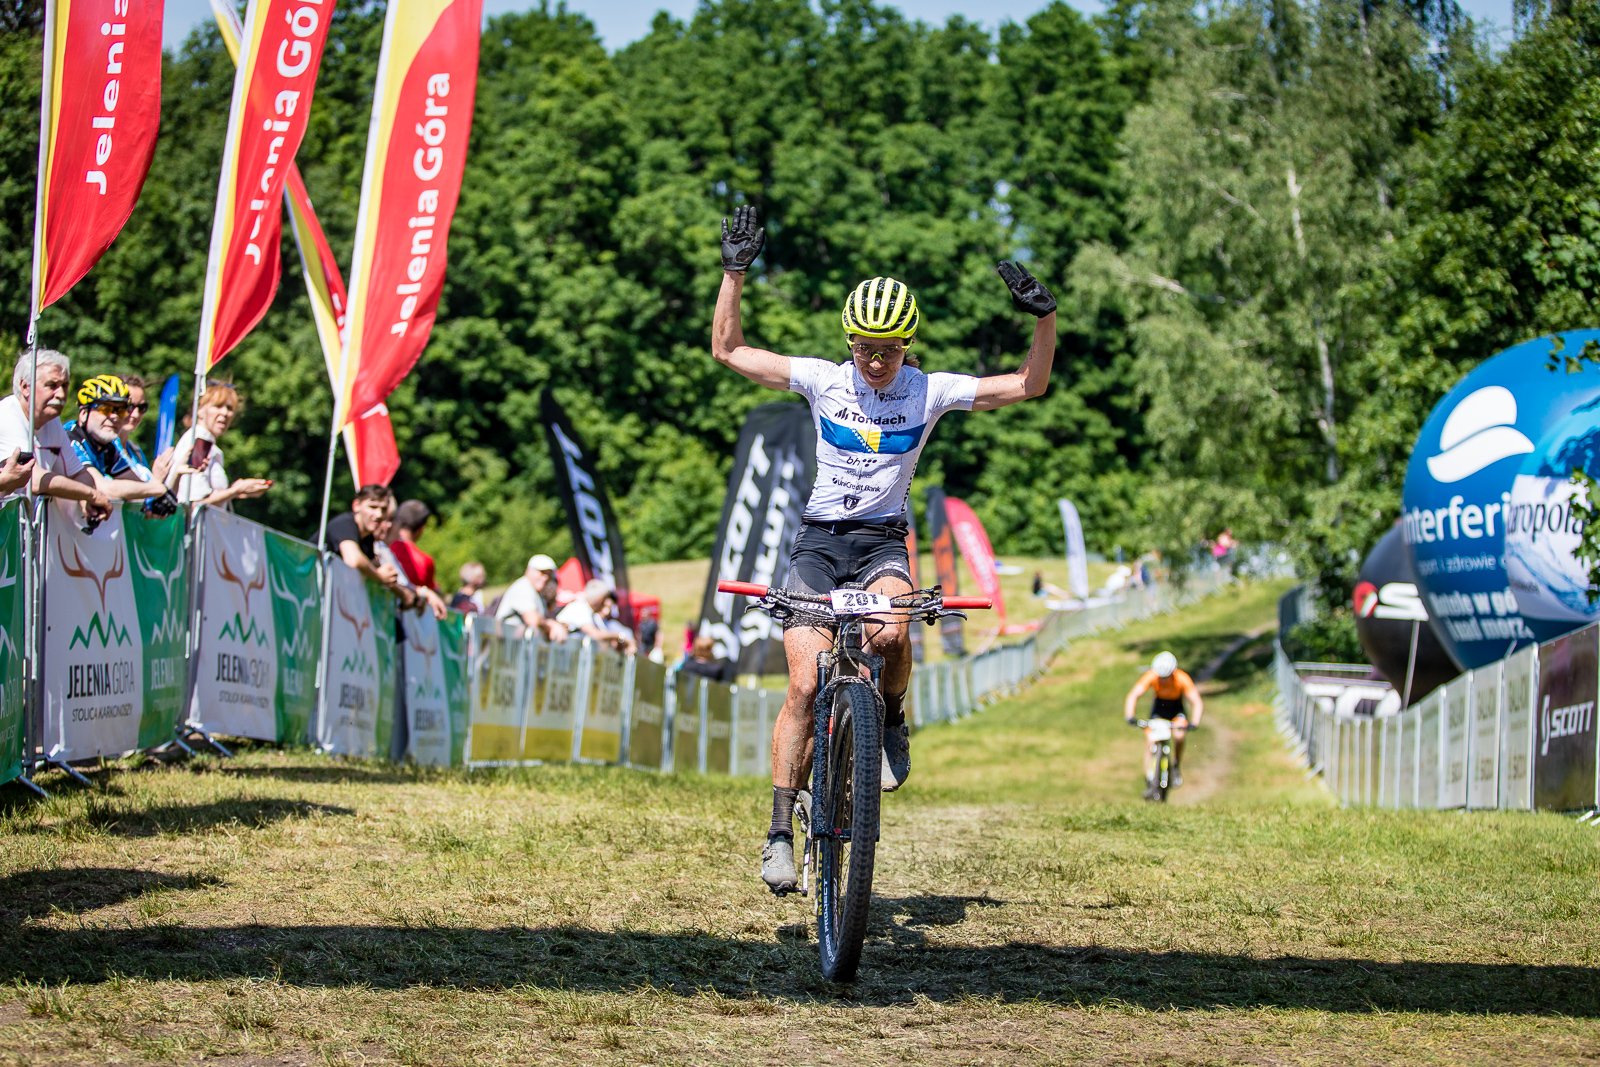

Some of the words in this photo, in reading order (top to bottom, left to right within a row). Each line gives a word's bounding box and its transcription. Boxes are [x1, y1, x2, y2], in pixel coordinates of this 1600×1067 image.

[277, 0, 323, 78] Gó
[413, 73, 450, 181] Góra
[391, 189, 439, 338] Jelenia
[852, 411, 906, 425] Tondach
[842, 592, 879, 607] 201
[67, 662, 112, 699] JELENIA
[1551, 701, 1595, 739] SCOTT
